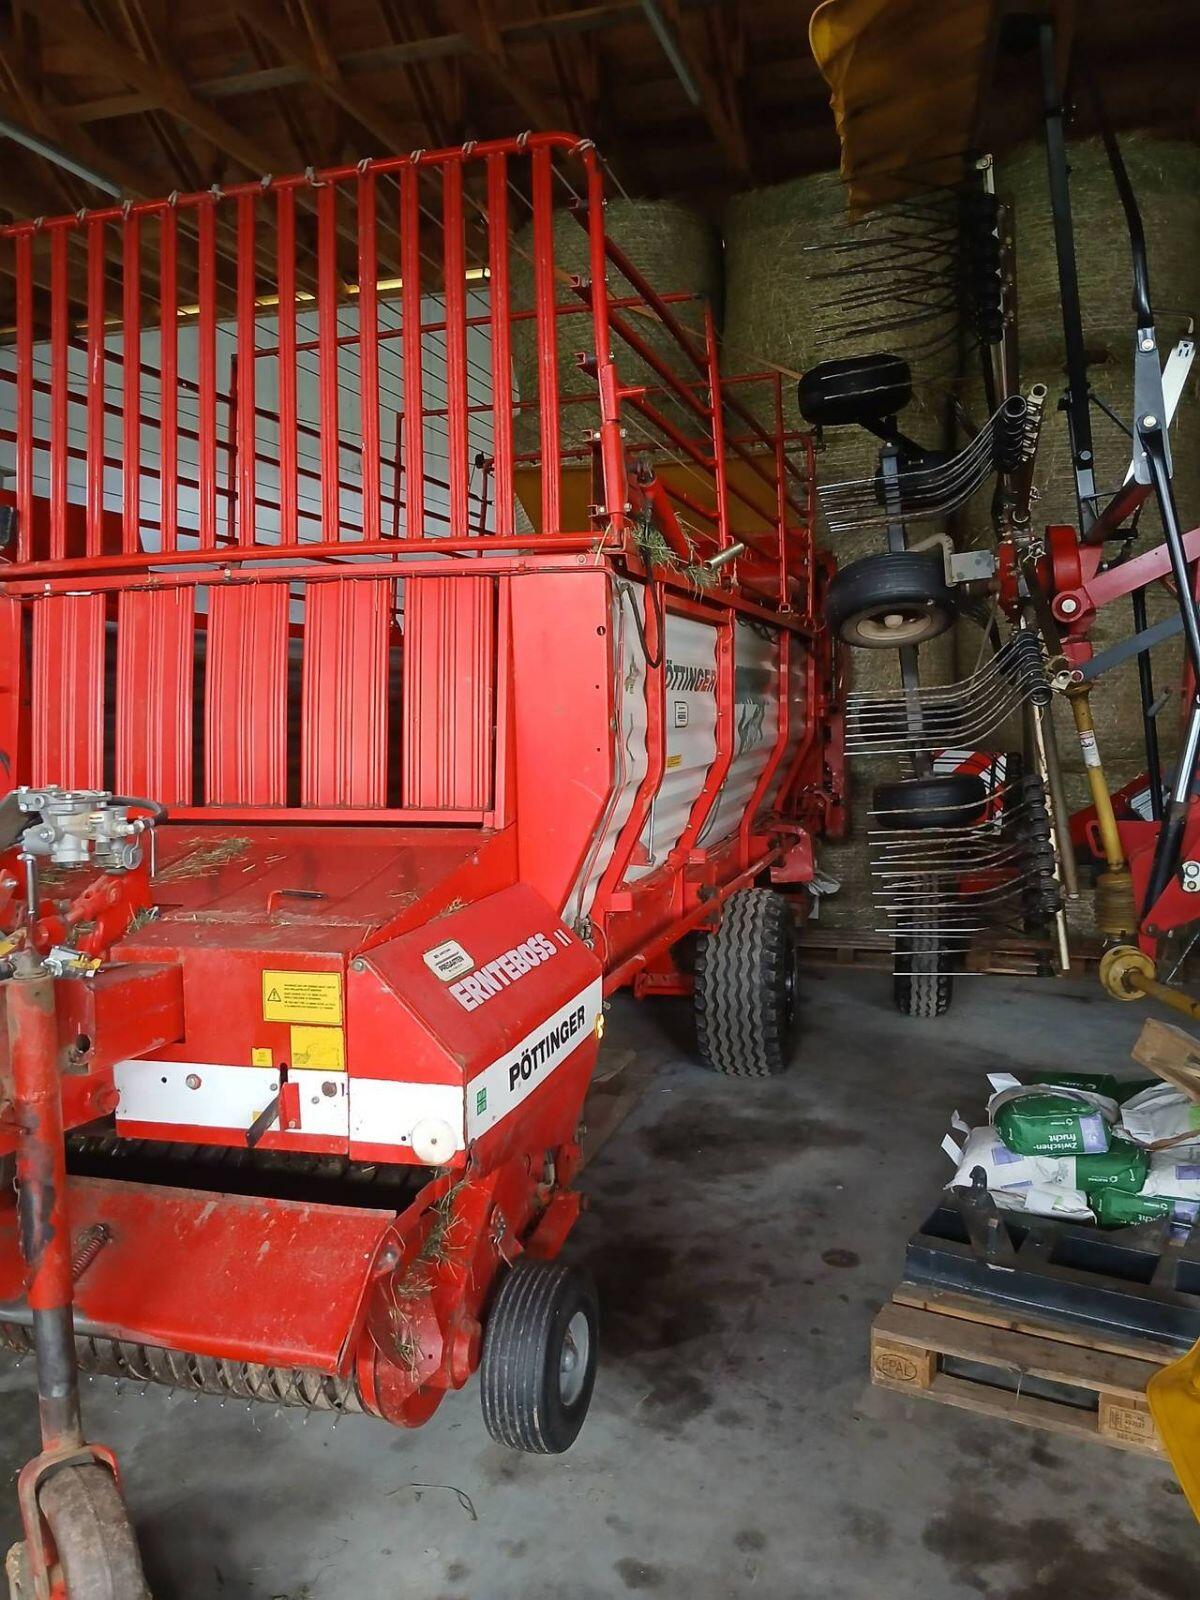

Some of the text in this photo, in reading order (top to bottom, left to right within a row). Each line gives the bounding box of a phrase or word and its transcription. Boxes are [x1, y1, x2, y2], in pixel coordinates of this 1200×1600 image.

[448, 932, 557, 1012] ERNTEBOSS
[509, 1004, 586, 1092] PÖTTINGER
[1033, 1142, 1078, 1150] Zwischen-
[1048, 1133, 1077, 1142] frucht
